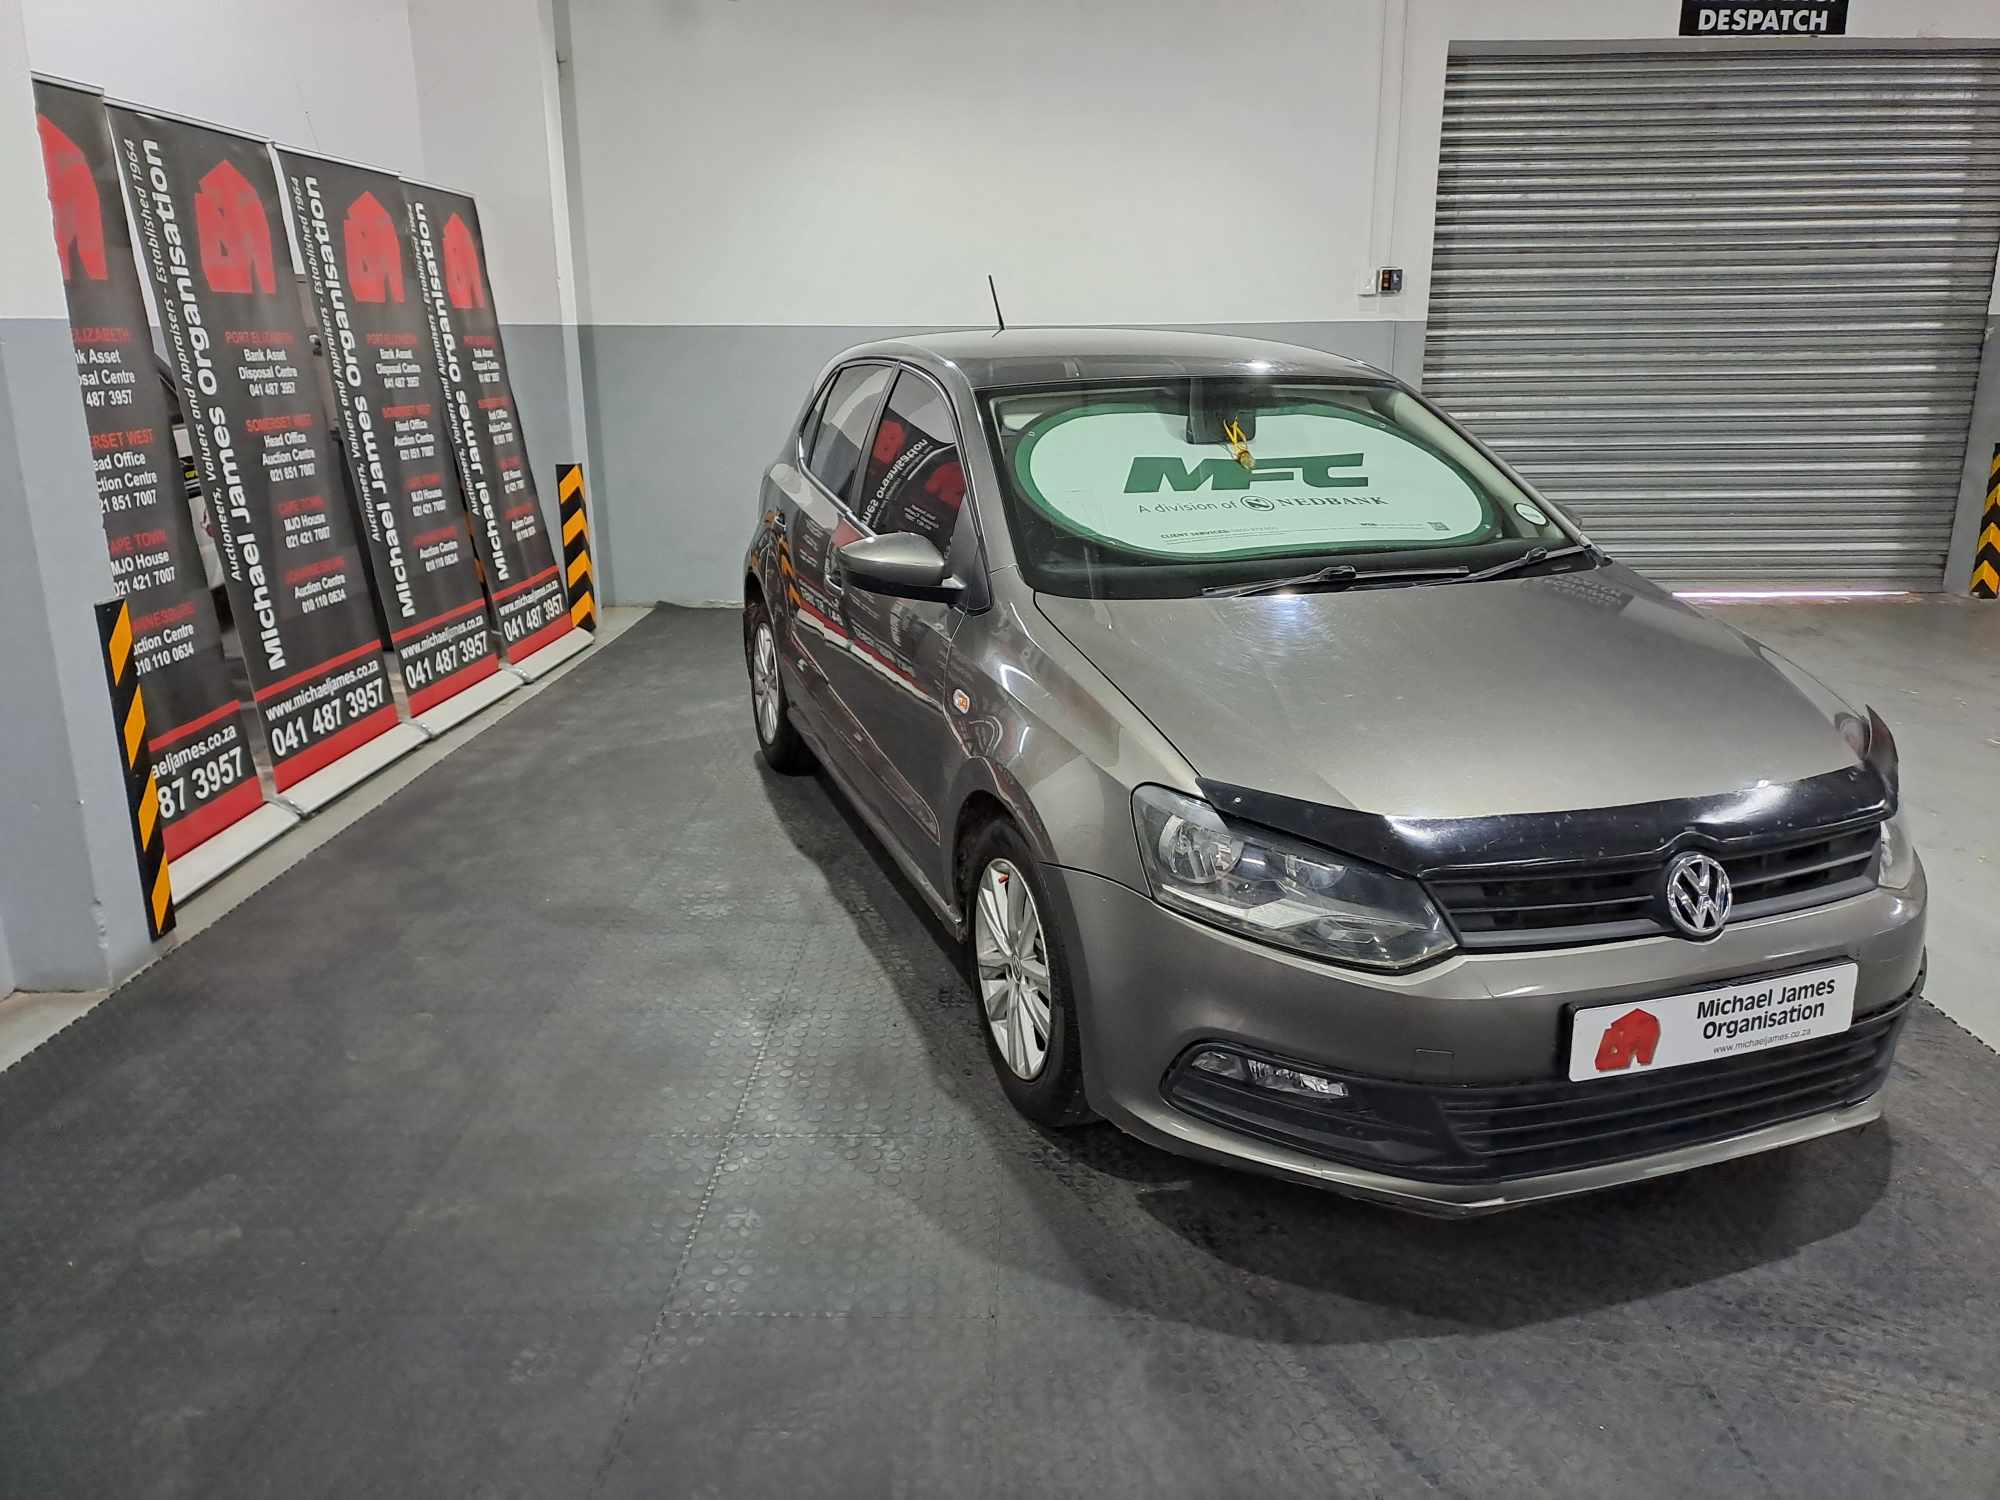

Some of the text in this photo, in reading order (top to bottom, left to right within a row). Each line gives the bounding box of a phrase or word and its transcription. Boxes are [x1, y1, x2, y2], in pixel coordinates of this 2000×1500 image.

[1698, 9, 1828, 31] DESPATCH
[124, 139, 144, 181] 1964
[134, 185, 168, 283] Established
[89, 349, 121, 364] Asset
[164, 298, 193, 384] Appraisers
[243, 348, 266, 361] Bank
[101, 369, 136, 385] Centre
[238, 365, 275, 382] Disposal
[86, 389, 133, 407] 487 3957
[142, 139, 286, 671] Michael James Organisation
[184, 388, 201, 420] and
[304, 176, 416, 618] Michael James Organisation
[455, 390, 484, 475] James
[114, 451, 146, 468] Office
[195, 423, 217, 482] Valuers
[262, 451, 292, 466] Auction
[124, 471, 158, 488] Centre
[1123, 453, 1369, 493] MFC
[111, 494, 132, 512] 851
[133, 489, 157, 507] 7007
[1138, 504, 1152, 514] A
[1154, 500, 1218, 513] division
[1221, 500, 1238, 509] of
[1276, 496, 1390, 508] NEDBANK
[475, 481, 510, 581] Michael
[111, 551, 169, 576] MJO House
[132, 574, 152, 591] 421
[153, 566, 176, 585] 7007
[163, 623, 195, 644] Centre
[503, 593, 564, 642] 041 487 3957
[152, 648, 171, 669] 110
[405, 630, 488, 689] 041 487 3957
[265, 660, 379, 721] www.michaeljames.co.za
[271, 678, 384, 757] 041 487 3957
[151, 725, 237, 779] aeljames.co.za
[157, 746, 242, 818] 87 3957
[1697, 979, 1835, 1019] Michael James
[1703, 1002, 1825, 1039] Organisation
[1713, 1028, 1811, 1055] www.michaeljames.co.za
